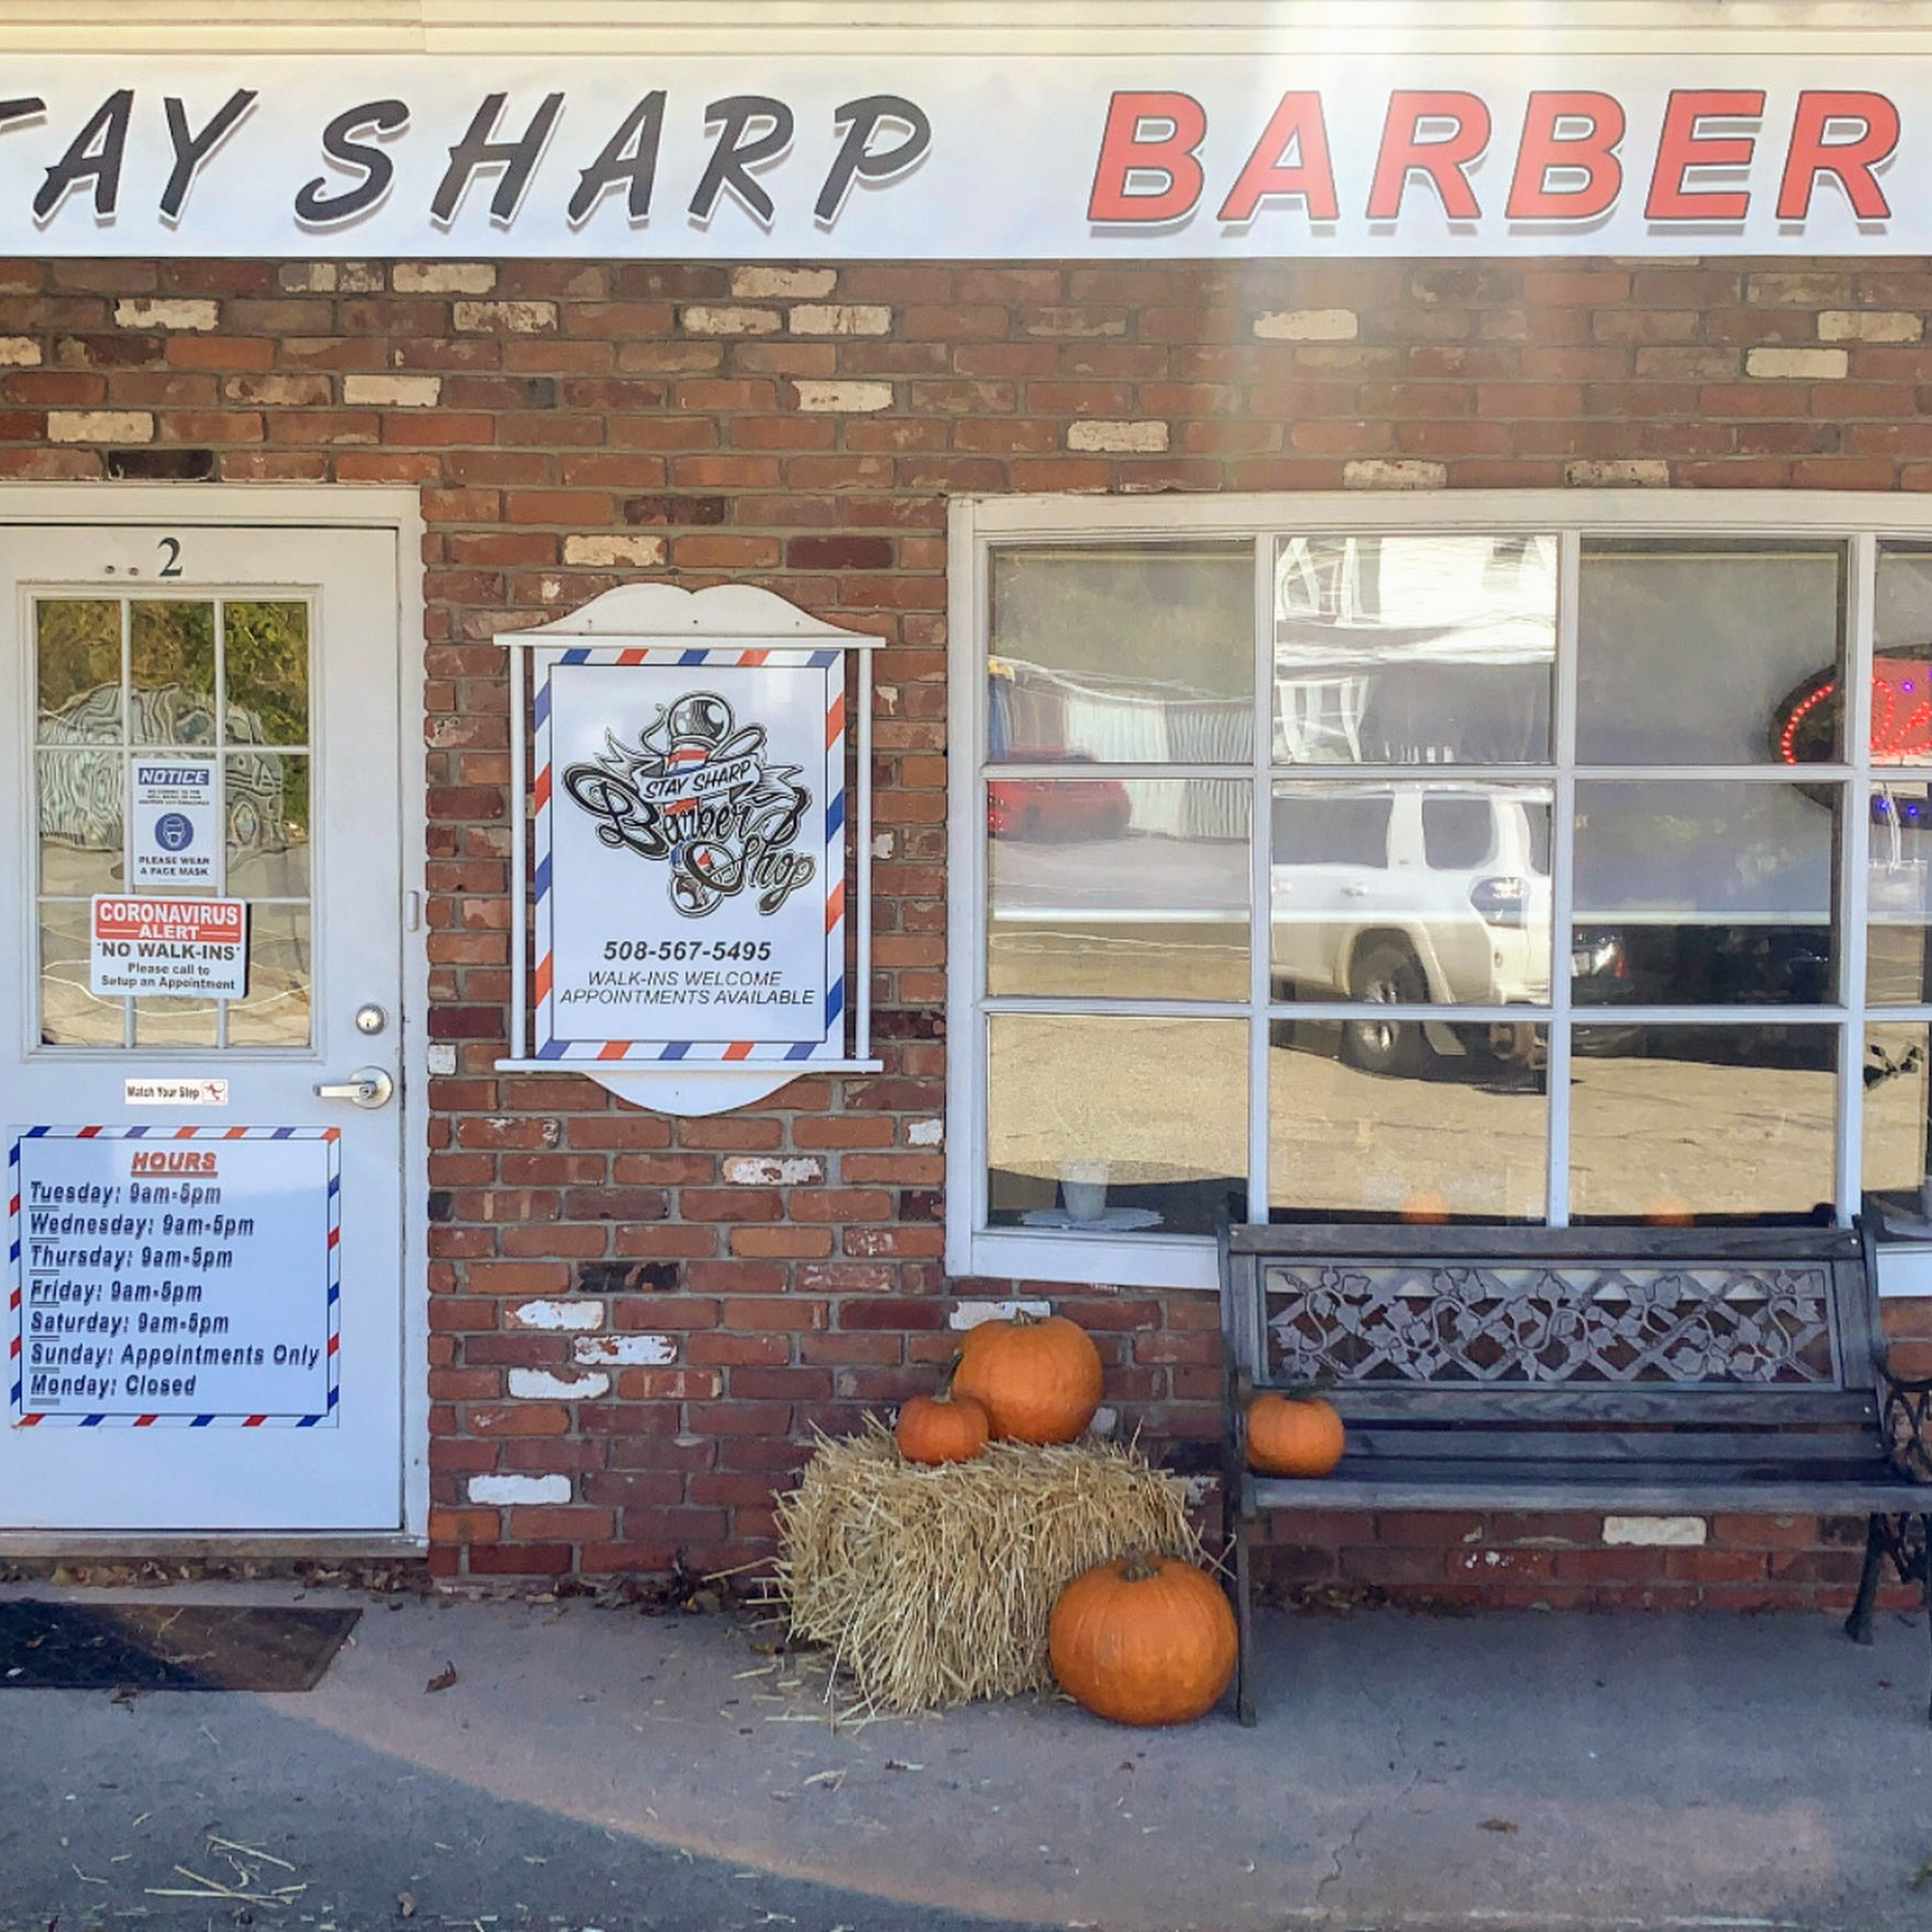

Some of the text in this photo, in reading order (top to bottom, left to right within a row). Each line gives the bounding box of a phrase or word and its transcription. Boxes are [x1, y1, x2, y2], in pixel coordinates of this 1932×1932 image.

[293, 90, 932, 229] SHARP
[1087, 90, 1902, 225] BARBER
[156, 537, 183, 577] 2
[141, 769, 208, 783] NOTICE
[642, 759, 752, 800] STAY SHARP
[563, 765, 811, 860] Barber
[138, 856, 177, 865] PLEASE
[150, 867, 176, 876] FACE
[179, 867, 209, 876] MASK
[685, 835, 815, 915] Shop
[99, 902, 238, 924] CORONAVIRUS
[138, 923, 200, 940] ALERT
[604, 941, 771, 960] 508-567-5495
[128, 962, 210, 976] Please call to
[588, 971, 782, 986] WALK-INS WELCOME
[100, 975, 235, 990] Setup an Appointment
[560, 989, 814, 1005] APPOINTMENTS AVAILABLE
[128, 1086, 200, 1100] Watch Your Step
[131, 1151, 217, 1171] HOURS
[30, 1181, 221, 1207] Tuesday: 9am-5pm
[30, 1213, 254, 1237] Wednesday: 9am-5pm
[30, 1245, 233, 1271] Thursday: 9am-5pm
[30, 1280, 203, 1304] Friday: 9am-5pm
[30, 1312, 229, 1336] Saturday: 9am-5pm
[30, 1343, 319, 1370] Sunday: Appointments Only
[30, 1375, 196, 1399] Monday: Closed
